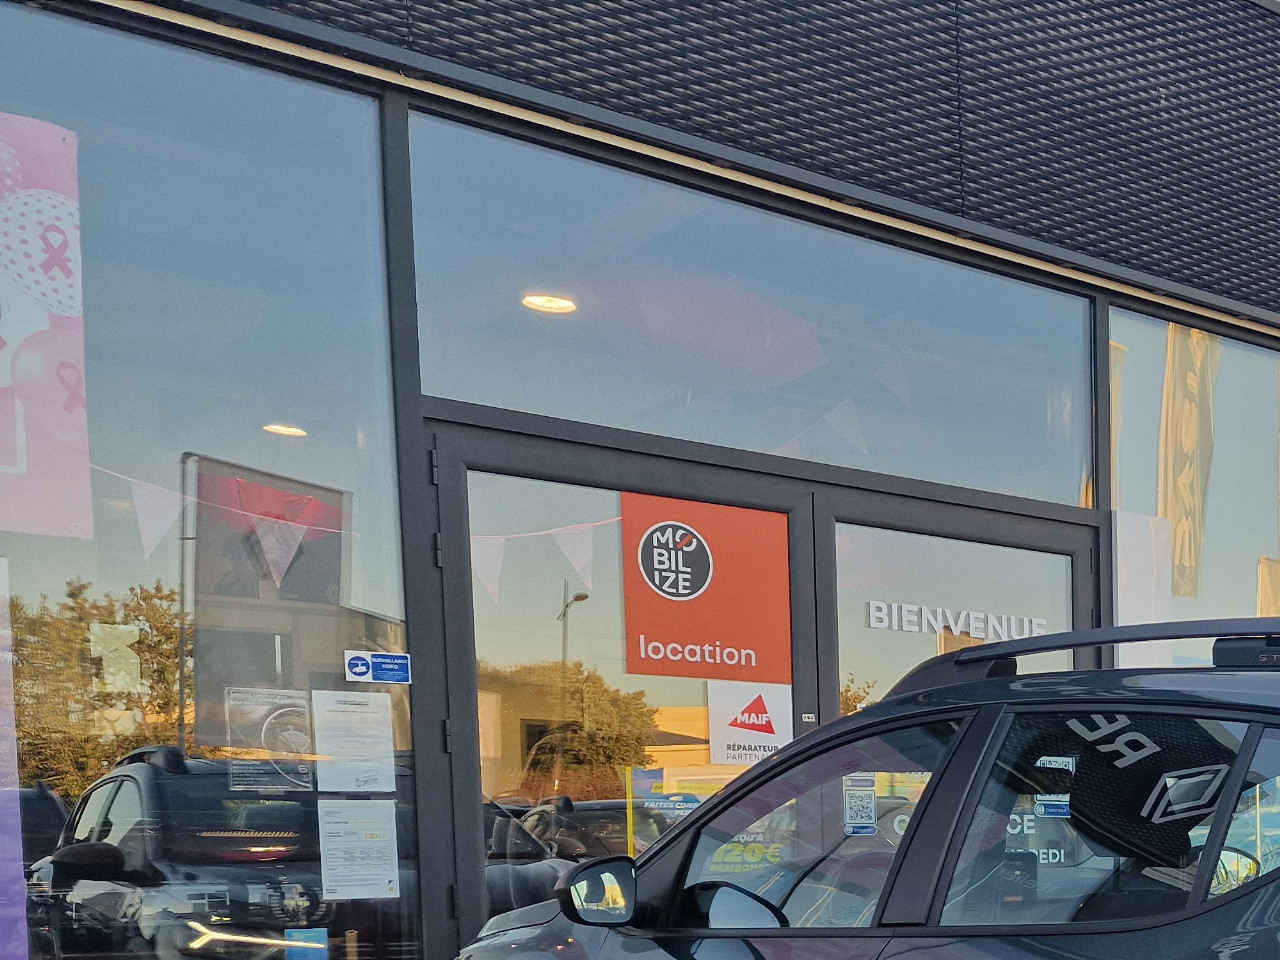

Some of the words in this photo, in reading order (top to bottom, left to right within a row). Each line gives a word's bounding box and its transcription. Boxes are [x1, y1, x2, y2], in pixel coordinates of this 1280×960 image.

[653, 548, 692, 572] BIL
[654, 571, 692, 594] IZE
[868, 600, 1047, 640] BIENVENUE
[639, 634, 757, 667] location
[737, 712, 771, 725] MAIF
[726, 742, 779, 752] RÉPARATEUR
